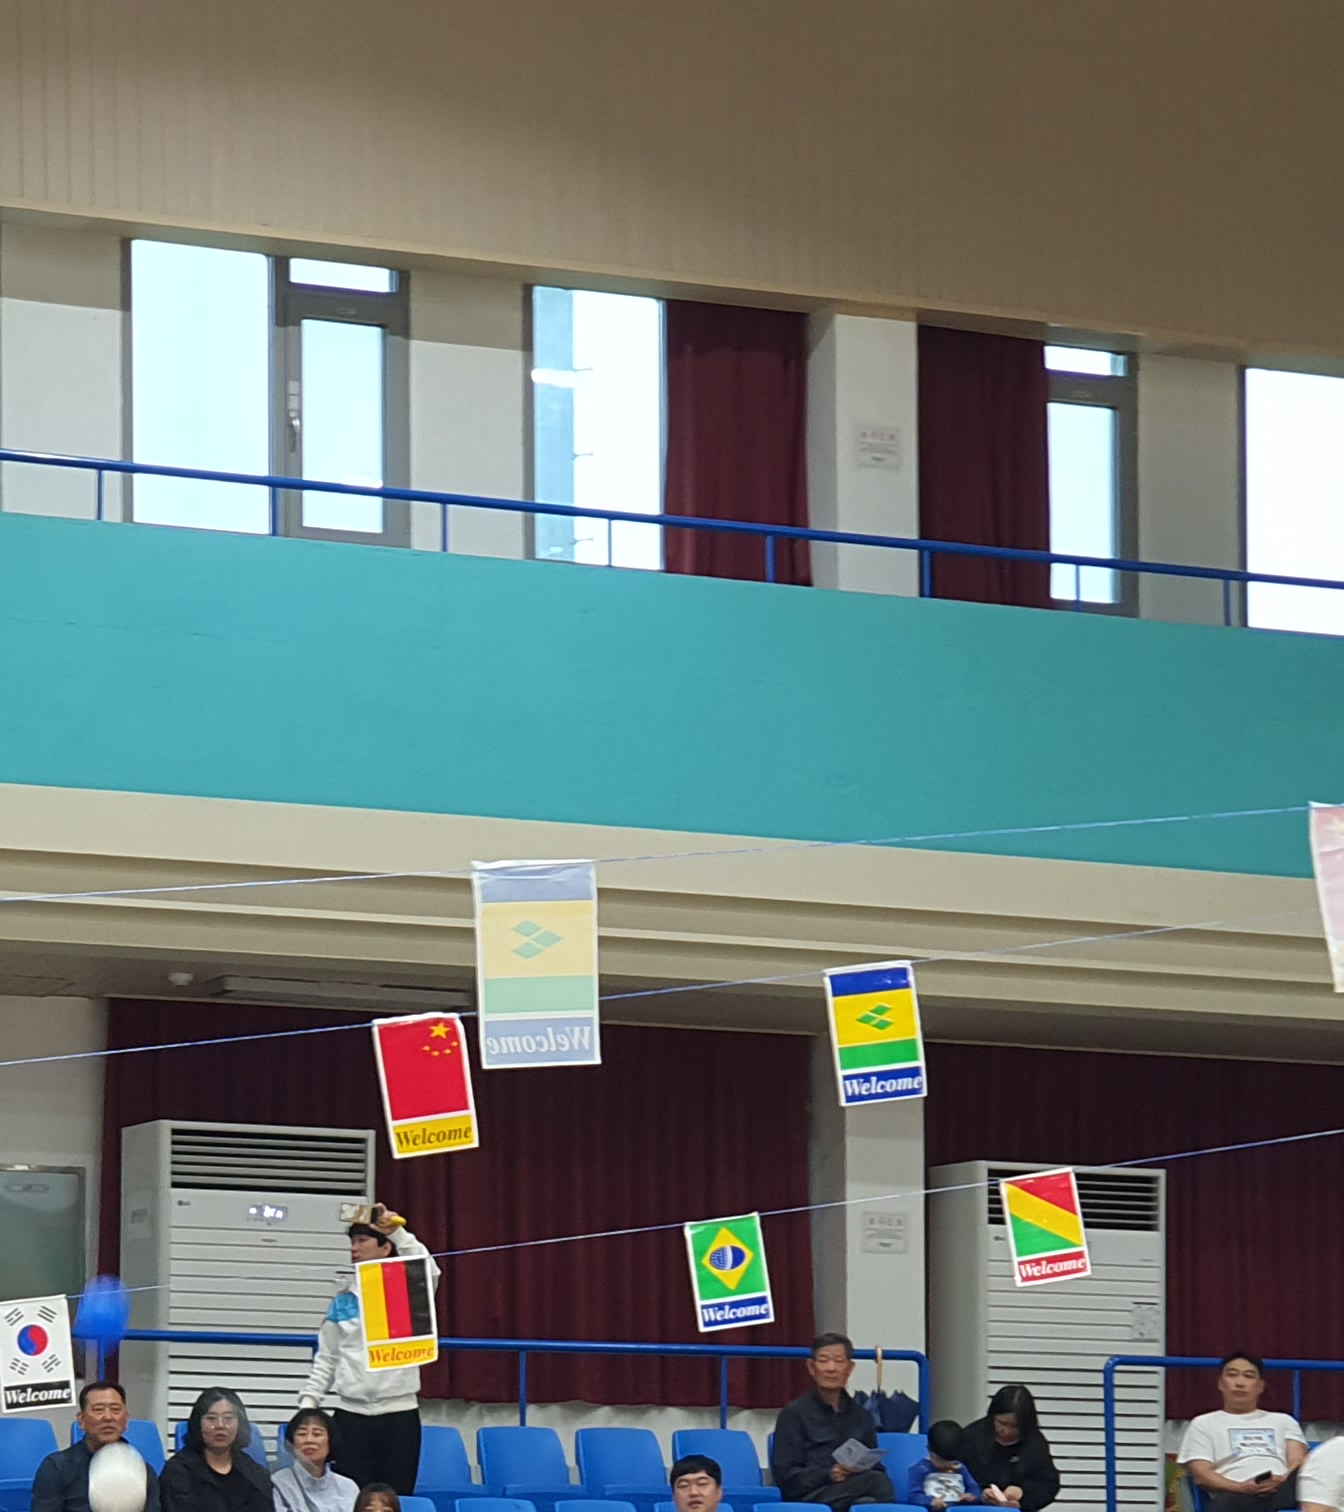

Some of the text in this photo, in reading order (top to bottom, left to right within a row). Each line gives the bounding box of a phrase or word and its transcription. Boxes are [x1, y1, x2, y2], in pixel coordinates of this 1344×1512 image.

[843, 1075, 923, 1096] Welcome
[395, 1125, 472, 1148] Welcome
[1019, 1257, 1086, 1278] Welcome
[702, 1303, 769, 1323] Welcome
[368, 1345, 435, 1364] Welcome
[4, 1384, 71, 1404] Welcome
